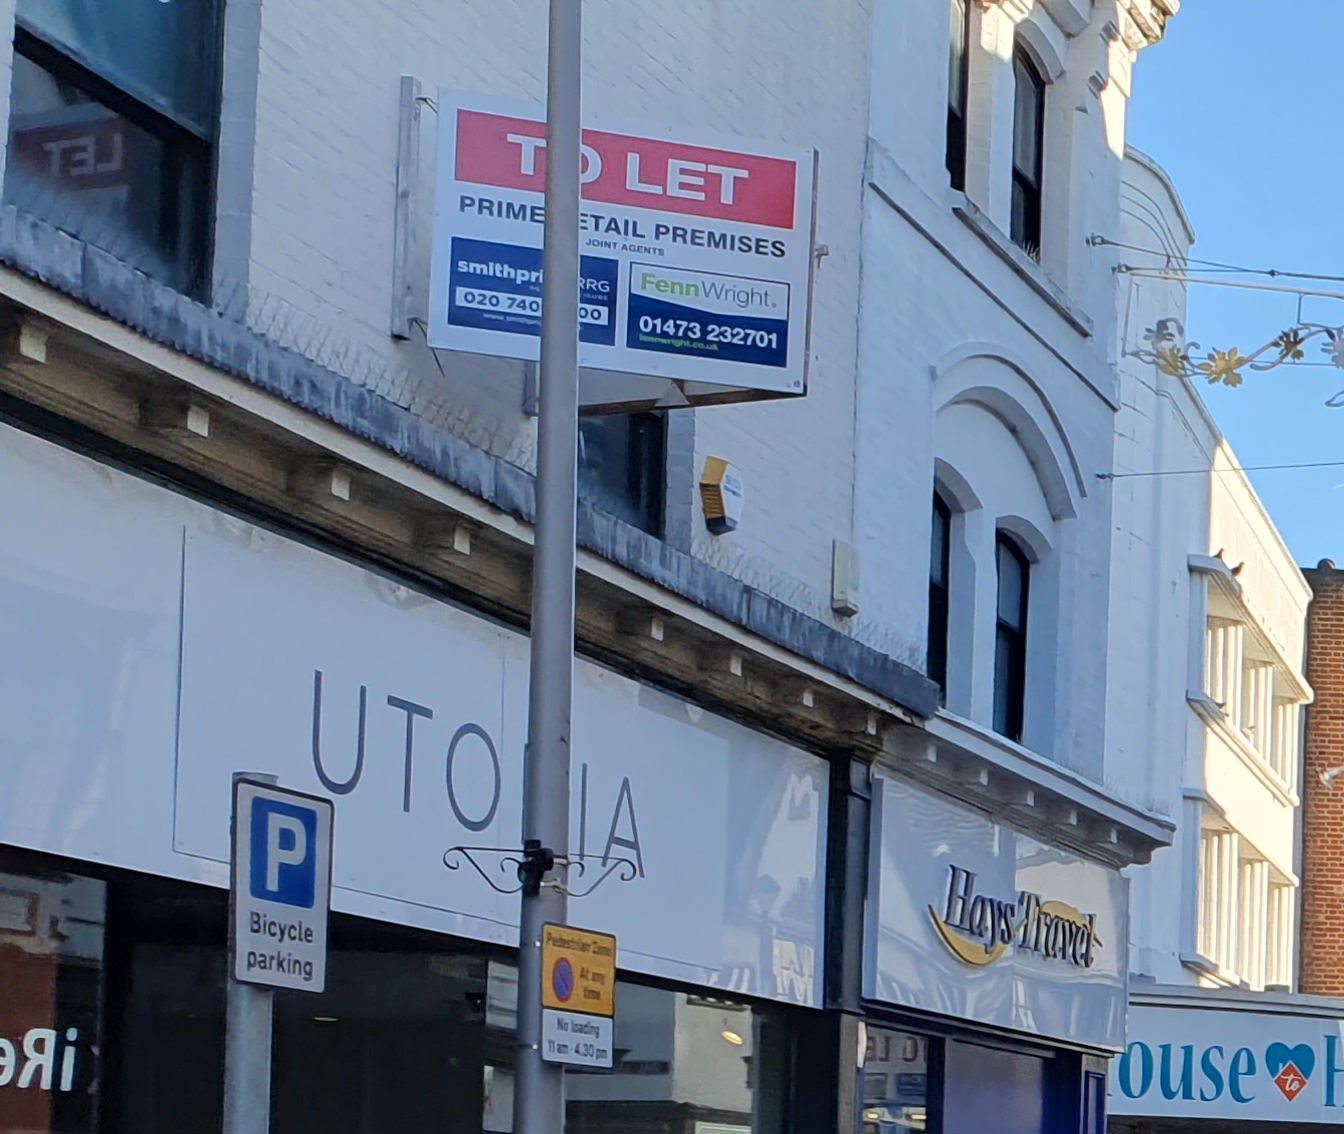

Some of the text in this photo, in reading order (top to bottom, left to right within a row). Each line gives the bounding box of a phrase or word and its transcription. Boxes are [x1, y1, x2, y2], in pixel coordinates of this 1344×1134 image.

[626, 152, 749, 206] LET
[459, 194, 546, 224] PRIME
[654, 223, 787, 258] PREMISES
[585, 238, 665, 257] JOINT AGENTS
[463, 291, 501, 308] 020
[639, 315, 778, 349] 01473 232701
[312, 669, 645, 878] UTOIA
[266, 811, 307, 893] P
[250, 911, 313, 943] Bicycle
[943, 864, 1097, 969] Hays Travel
[247, 951, 313, 982] parking
[557, 1017, 601, 1040] No loading
[574, 1044, 594, 1058] 4.30
[596, 1048, 608, 1061] pm
[1107, 1041, 1257, 1105] ouse
[1281, 1073, 1301, 1091] to
